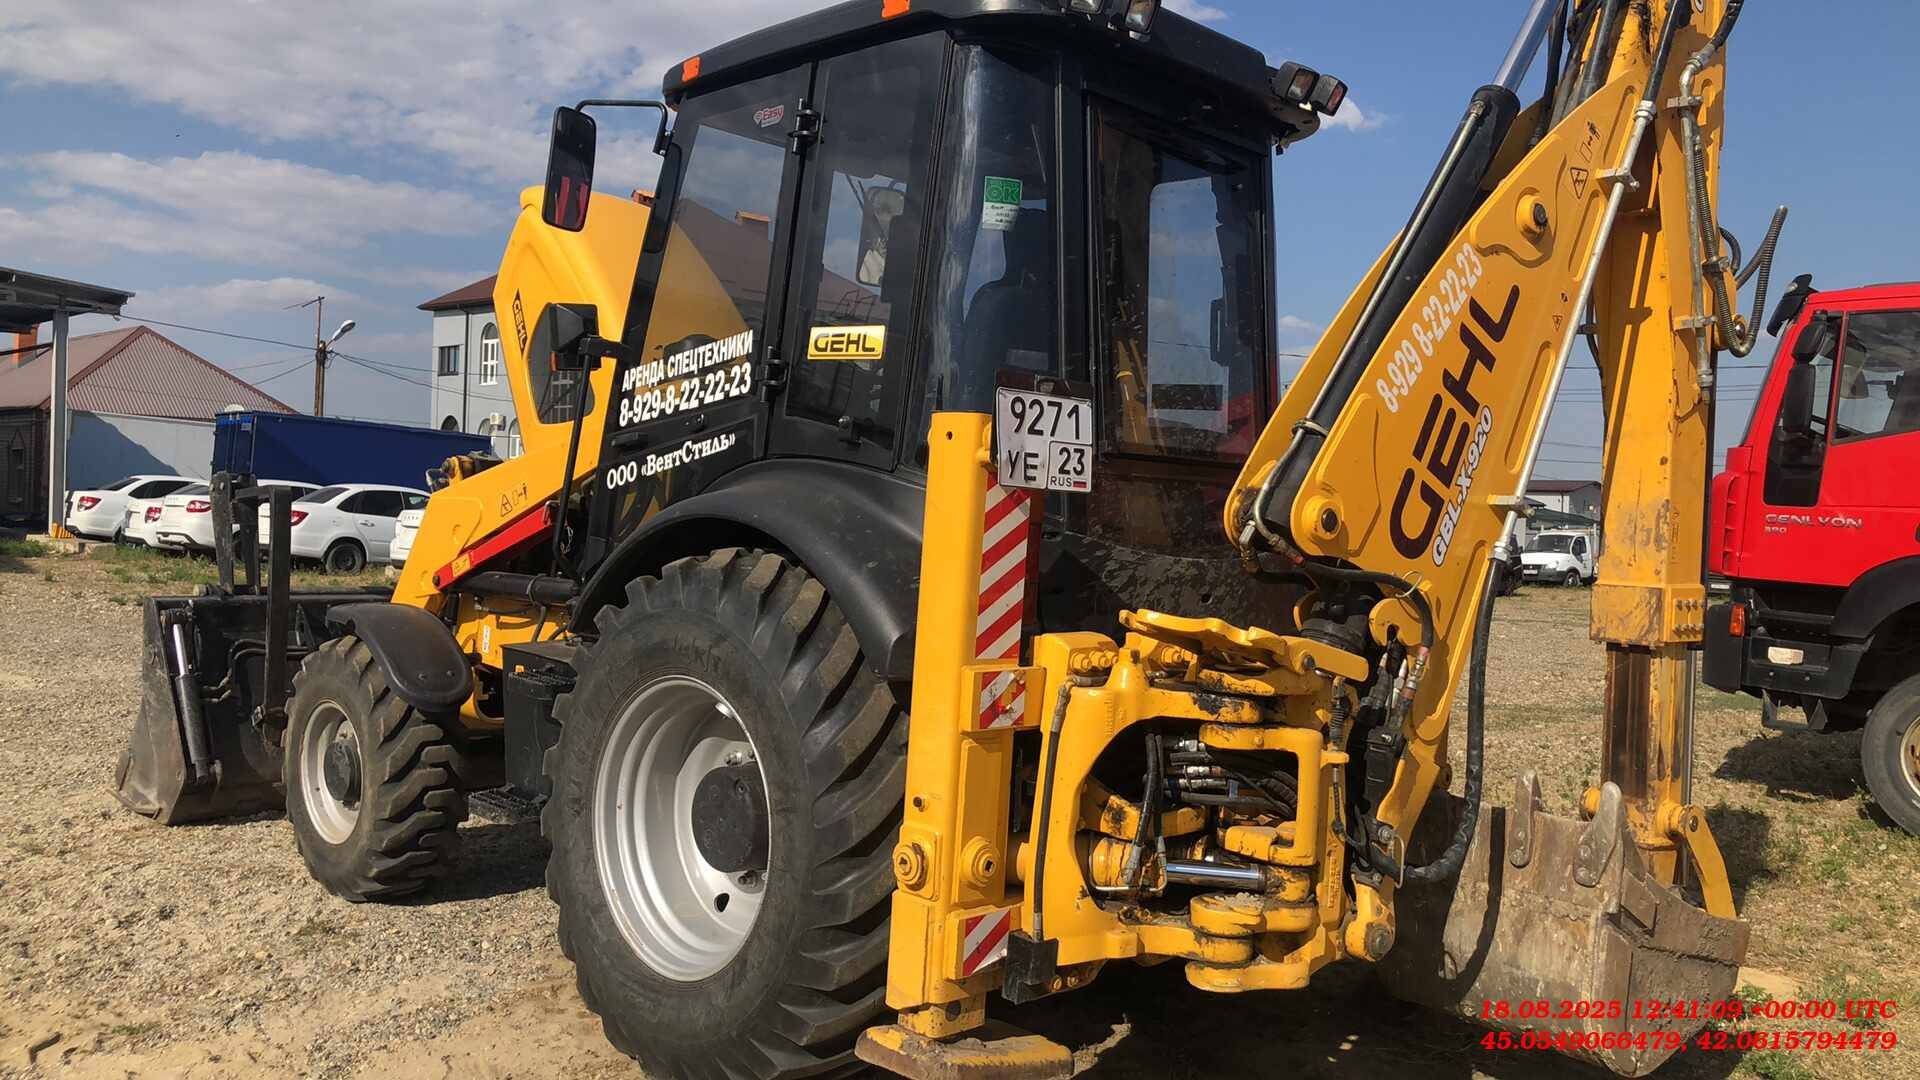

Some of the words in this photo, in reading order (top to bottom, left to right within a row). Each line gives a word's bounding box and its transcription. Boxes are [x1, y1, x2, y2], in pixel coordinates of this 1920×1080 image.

[813, 332, 876, 353] GEHL
[621, 359, 665, 393] АРЕНДА
[667, 329, 753, 378] СПЕЦТЕХНИКИ
[619, 362, 752, 427] 8-929-8-22-22-23
[1010, 396, 1080, 440] 9271
[1390, 284, 1520, 559] GEHL
[607, 461, 638, 490] ООО
[1058, 447, 1085, 475] 23
[1050, 476, 1072, 487] RUS
